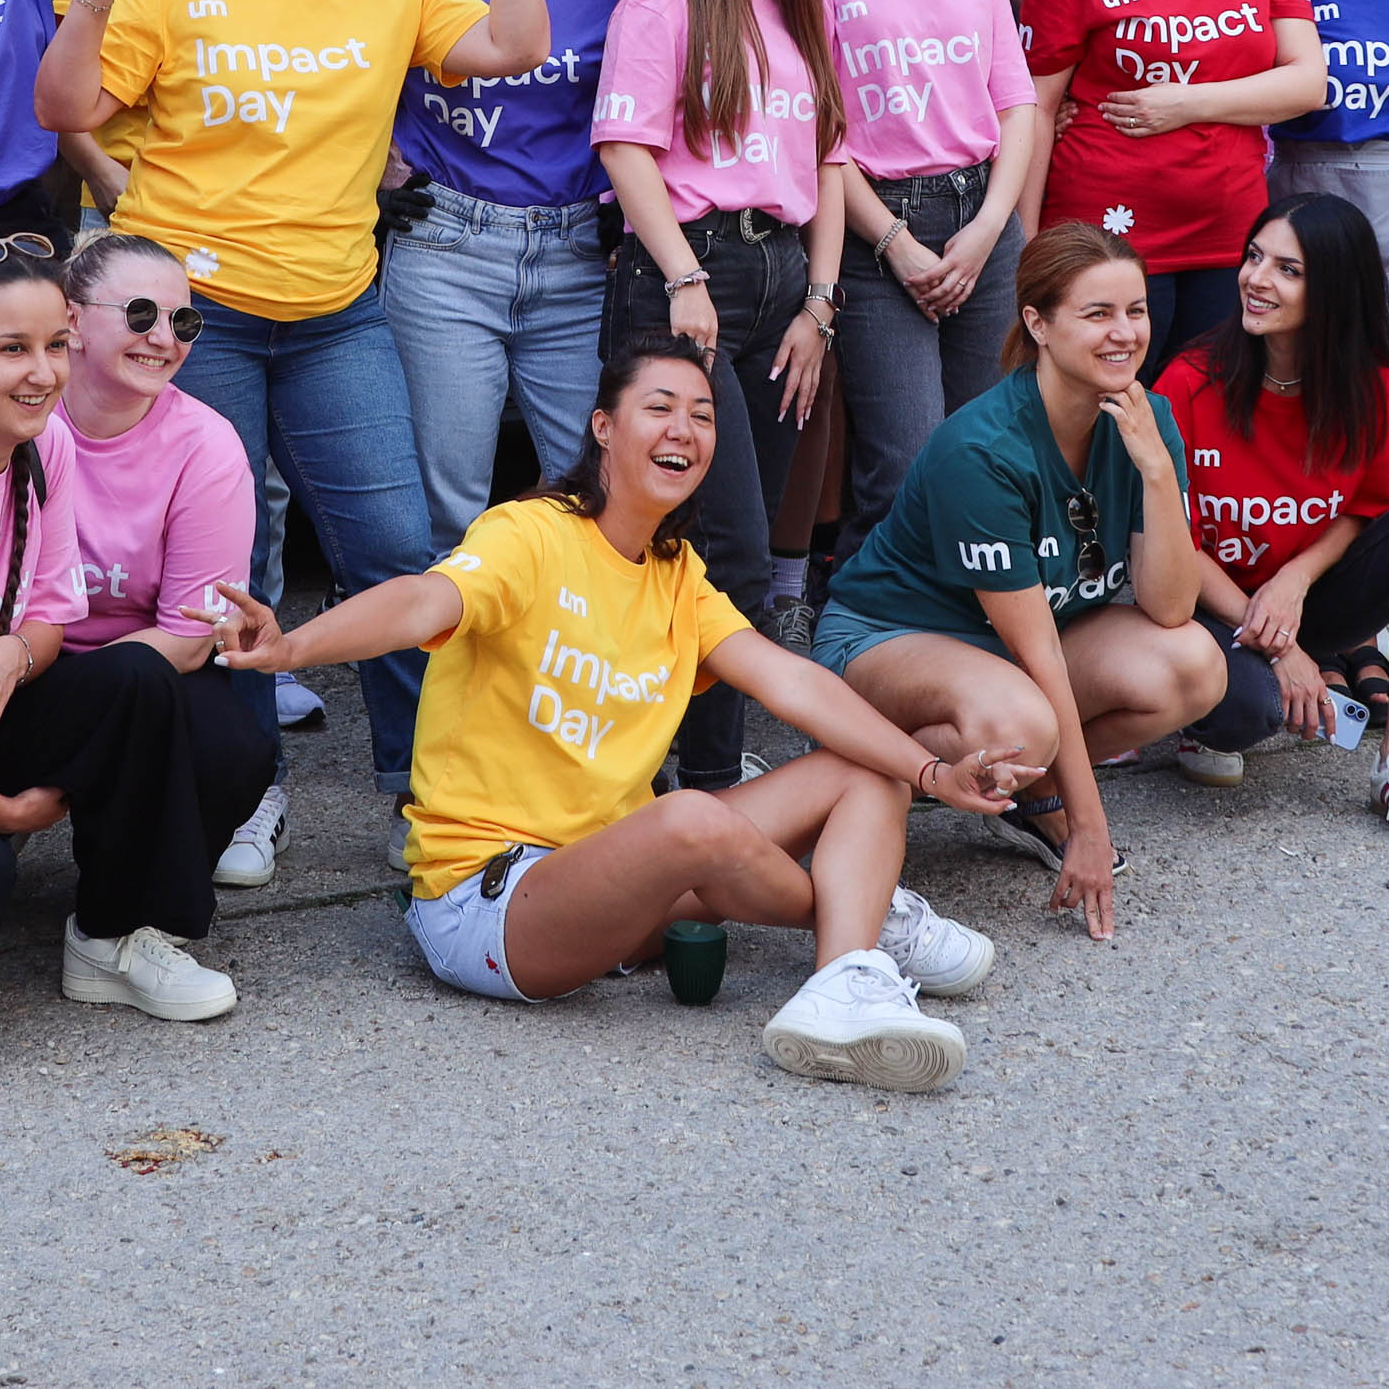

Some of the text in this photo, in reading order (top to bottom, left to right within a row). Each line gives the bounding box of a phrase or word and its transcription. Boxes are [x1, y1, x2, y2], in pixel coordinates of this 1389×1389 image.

[1114, 2, 1265, 54] Impact
[195, 38, 371, 82] Impact
[1115, 47, 1200, 85] Day
[201, 84, 297, 133] Day
[857, 81, 933, 123] Day
[1198, 490, 1345, 532] mpact
[958, 541, 1012, 572] um
[558, 586, 588, 618] um
[538, 629, 671, 706] Impact
[528, 683, 615, 760] Day
